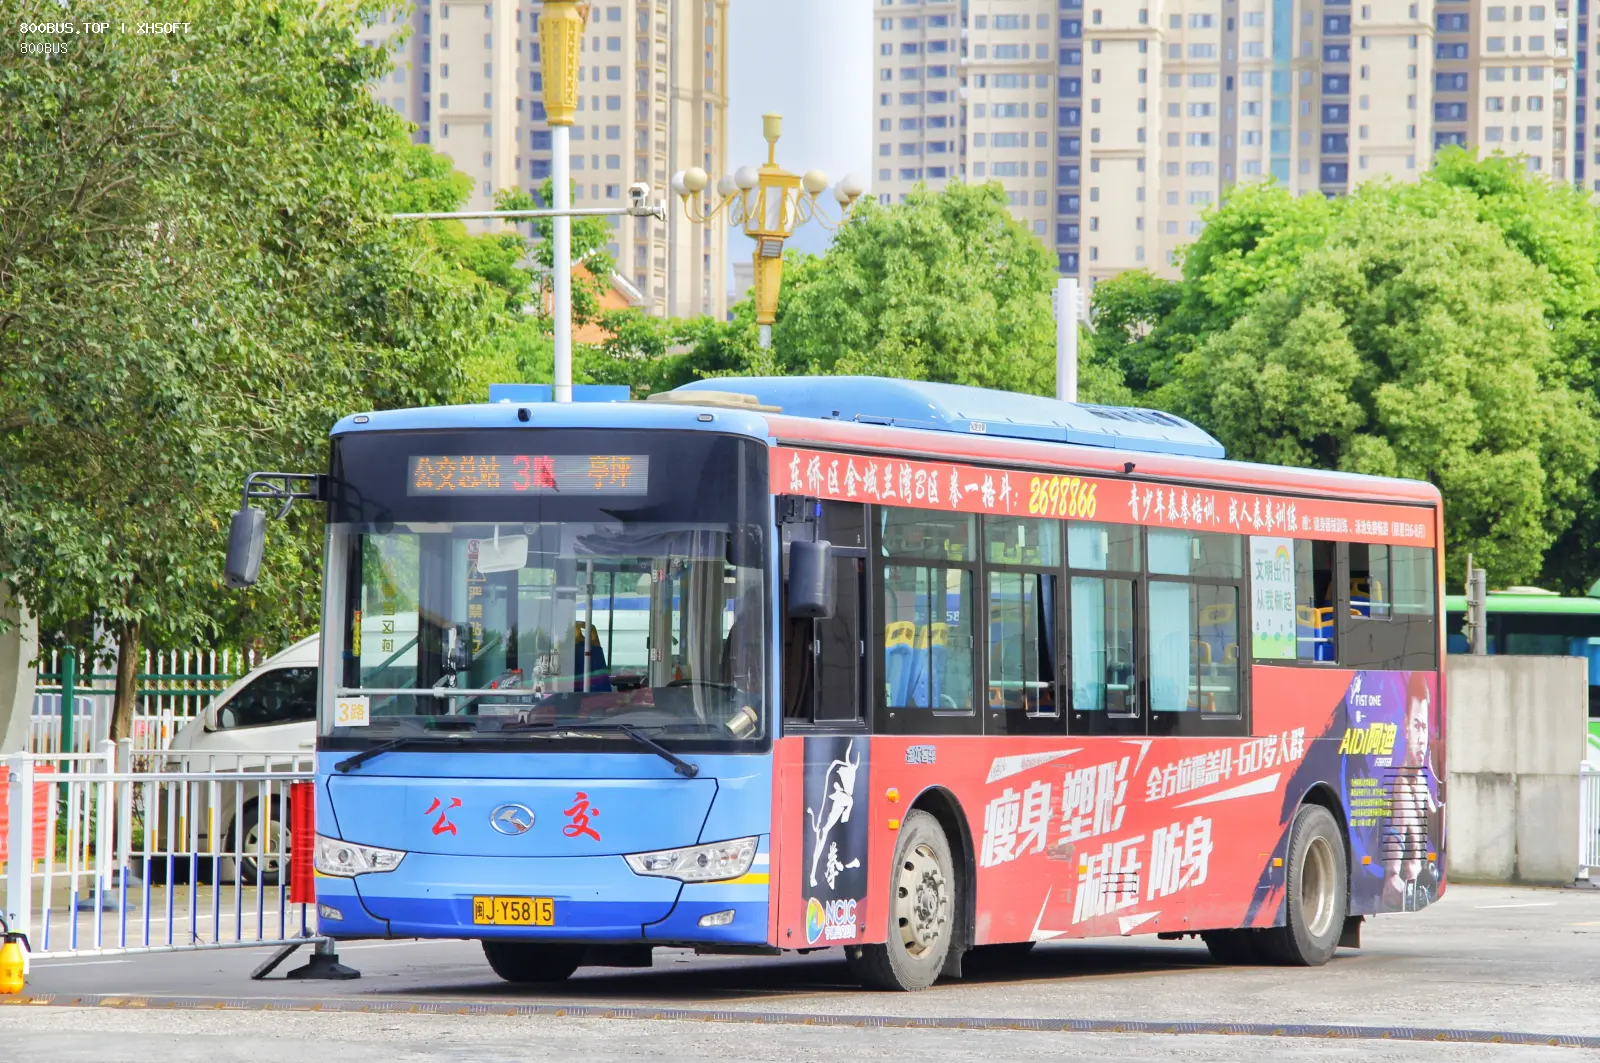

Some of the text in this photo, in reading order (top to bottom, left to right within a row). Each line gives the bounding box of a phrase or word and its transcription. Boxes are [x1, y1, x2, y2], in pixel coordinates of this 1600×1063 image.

[414, 455, 500, 491] 公交总站
[1028, 475, 1097, 518] 2698866
[338, 703, 364, 722] 3路
[1145, 727, 1305, 802] 全方位覆盖4-60岁人群
[424, 791, 600, 841] 公 交
[979, 755, 1131, 868] 瘦身 塑形
[1071, 815, 1214, 925] 减压 防身
[825, 898, 857, 926] NCIC
